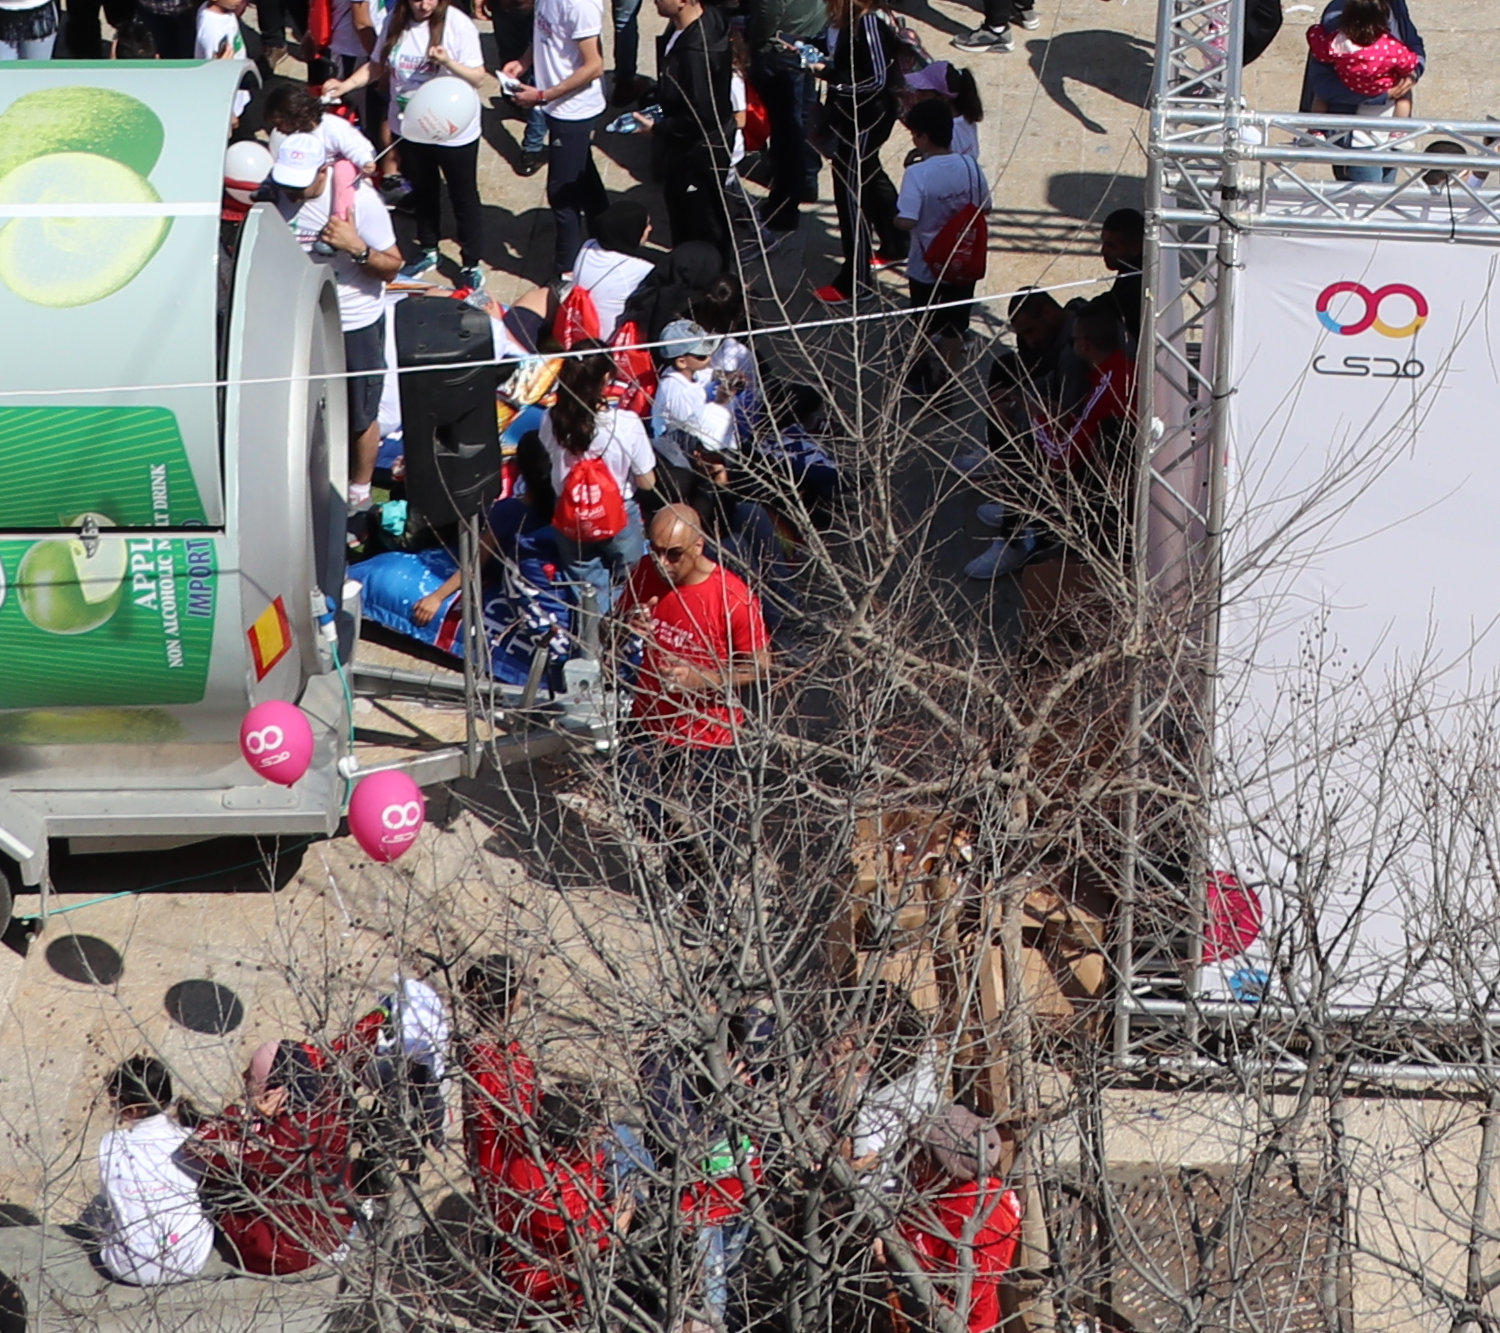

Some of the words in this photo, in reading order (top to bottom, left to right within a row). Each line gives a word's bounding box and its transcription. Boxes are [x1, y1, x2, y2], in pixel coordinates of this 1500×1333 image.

[150, 462, 169, 510] DRINK
[153, 512, 174, 551] MLT
[130, 523, 158, 612] APPL
[156, 553, 180, 637] ALCOHOLIC
[181, 519, 212, 618] IMPORT
[166, 638, 185, 669] NON
